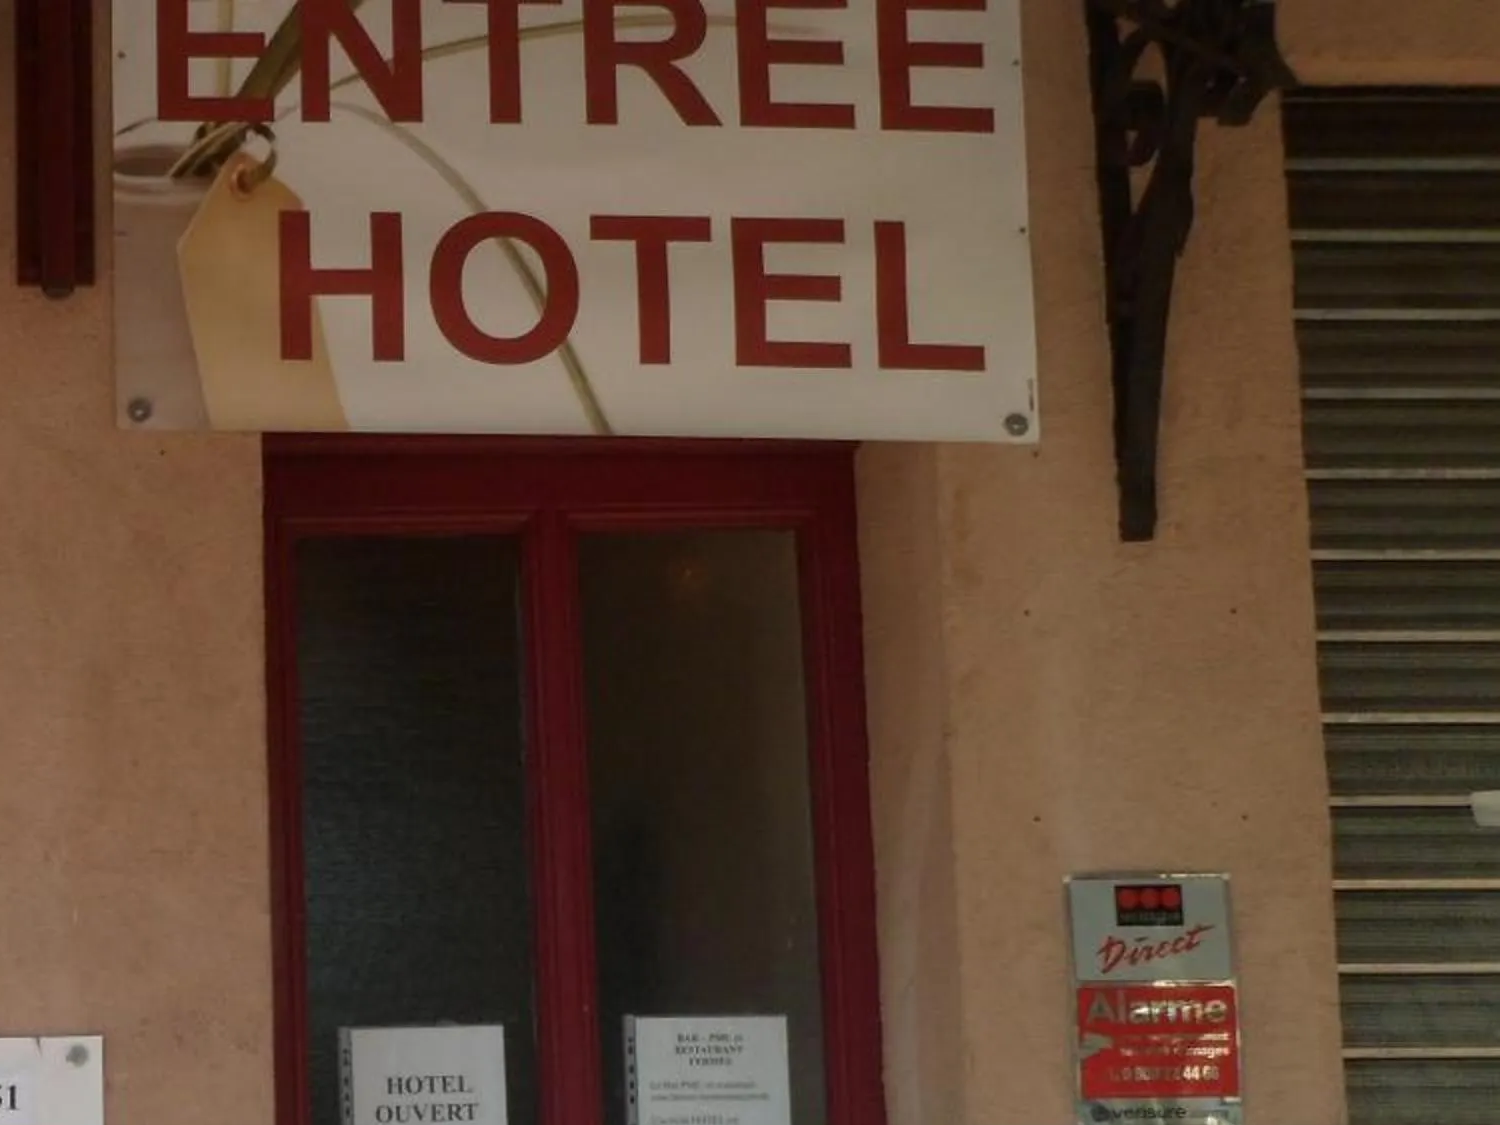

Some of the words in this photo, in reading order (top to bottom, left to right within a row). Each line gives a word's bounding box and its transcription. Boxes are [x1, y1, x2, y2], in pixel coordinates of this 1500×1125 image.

[156, 0, 995, 134] ENTREE
[278, 210, 987, 371] HOTEL
[1097, 925, 1215, 974] Direct
[1086, 989, 1228, 1025] Alarme
[386, 1075, 474, 1095] HOTEL
[375, 1103, 480, 1123] OUVERT
